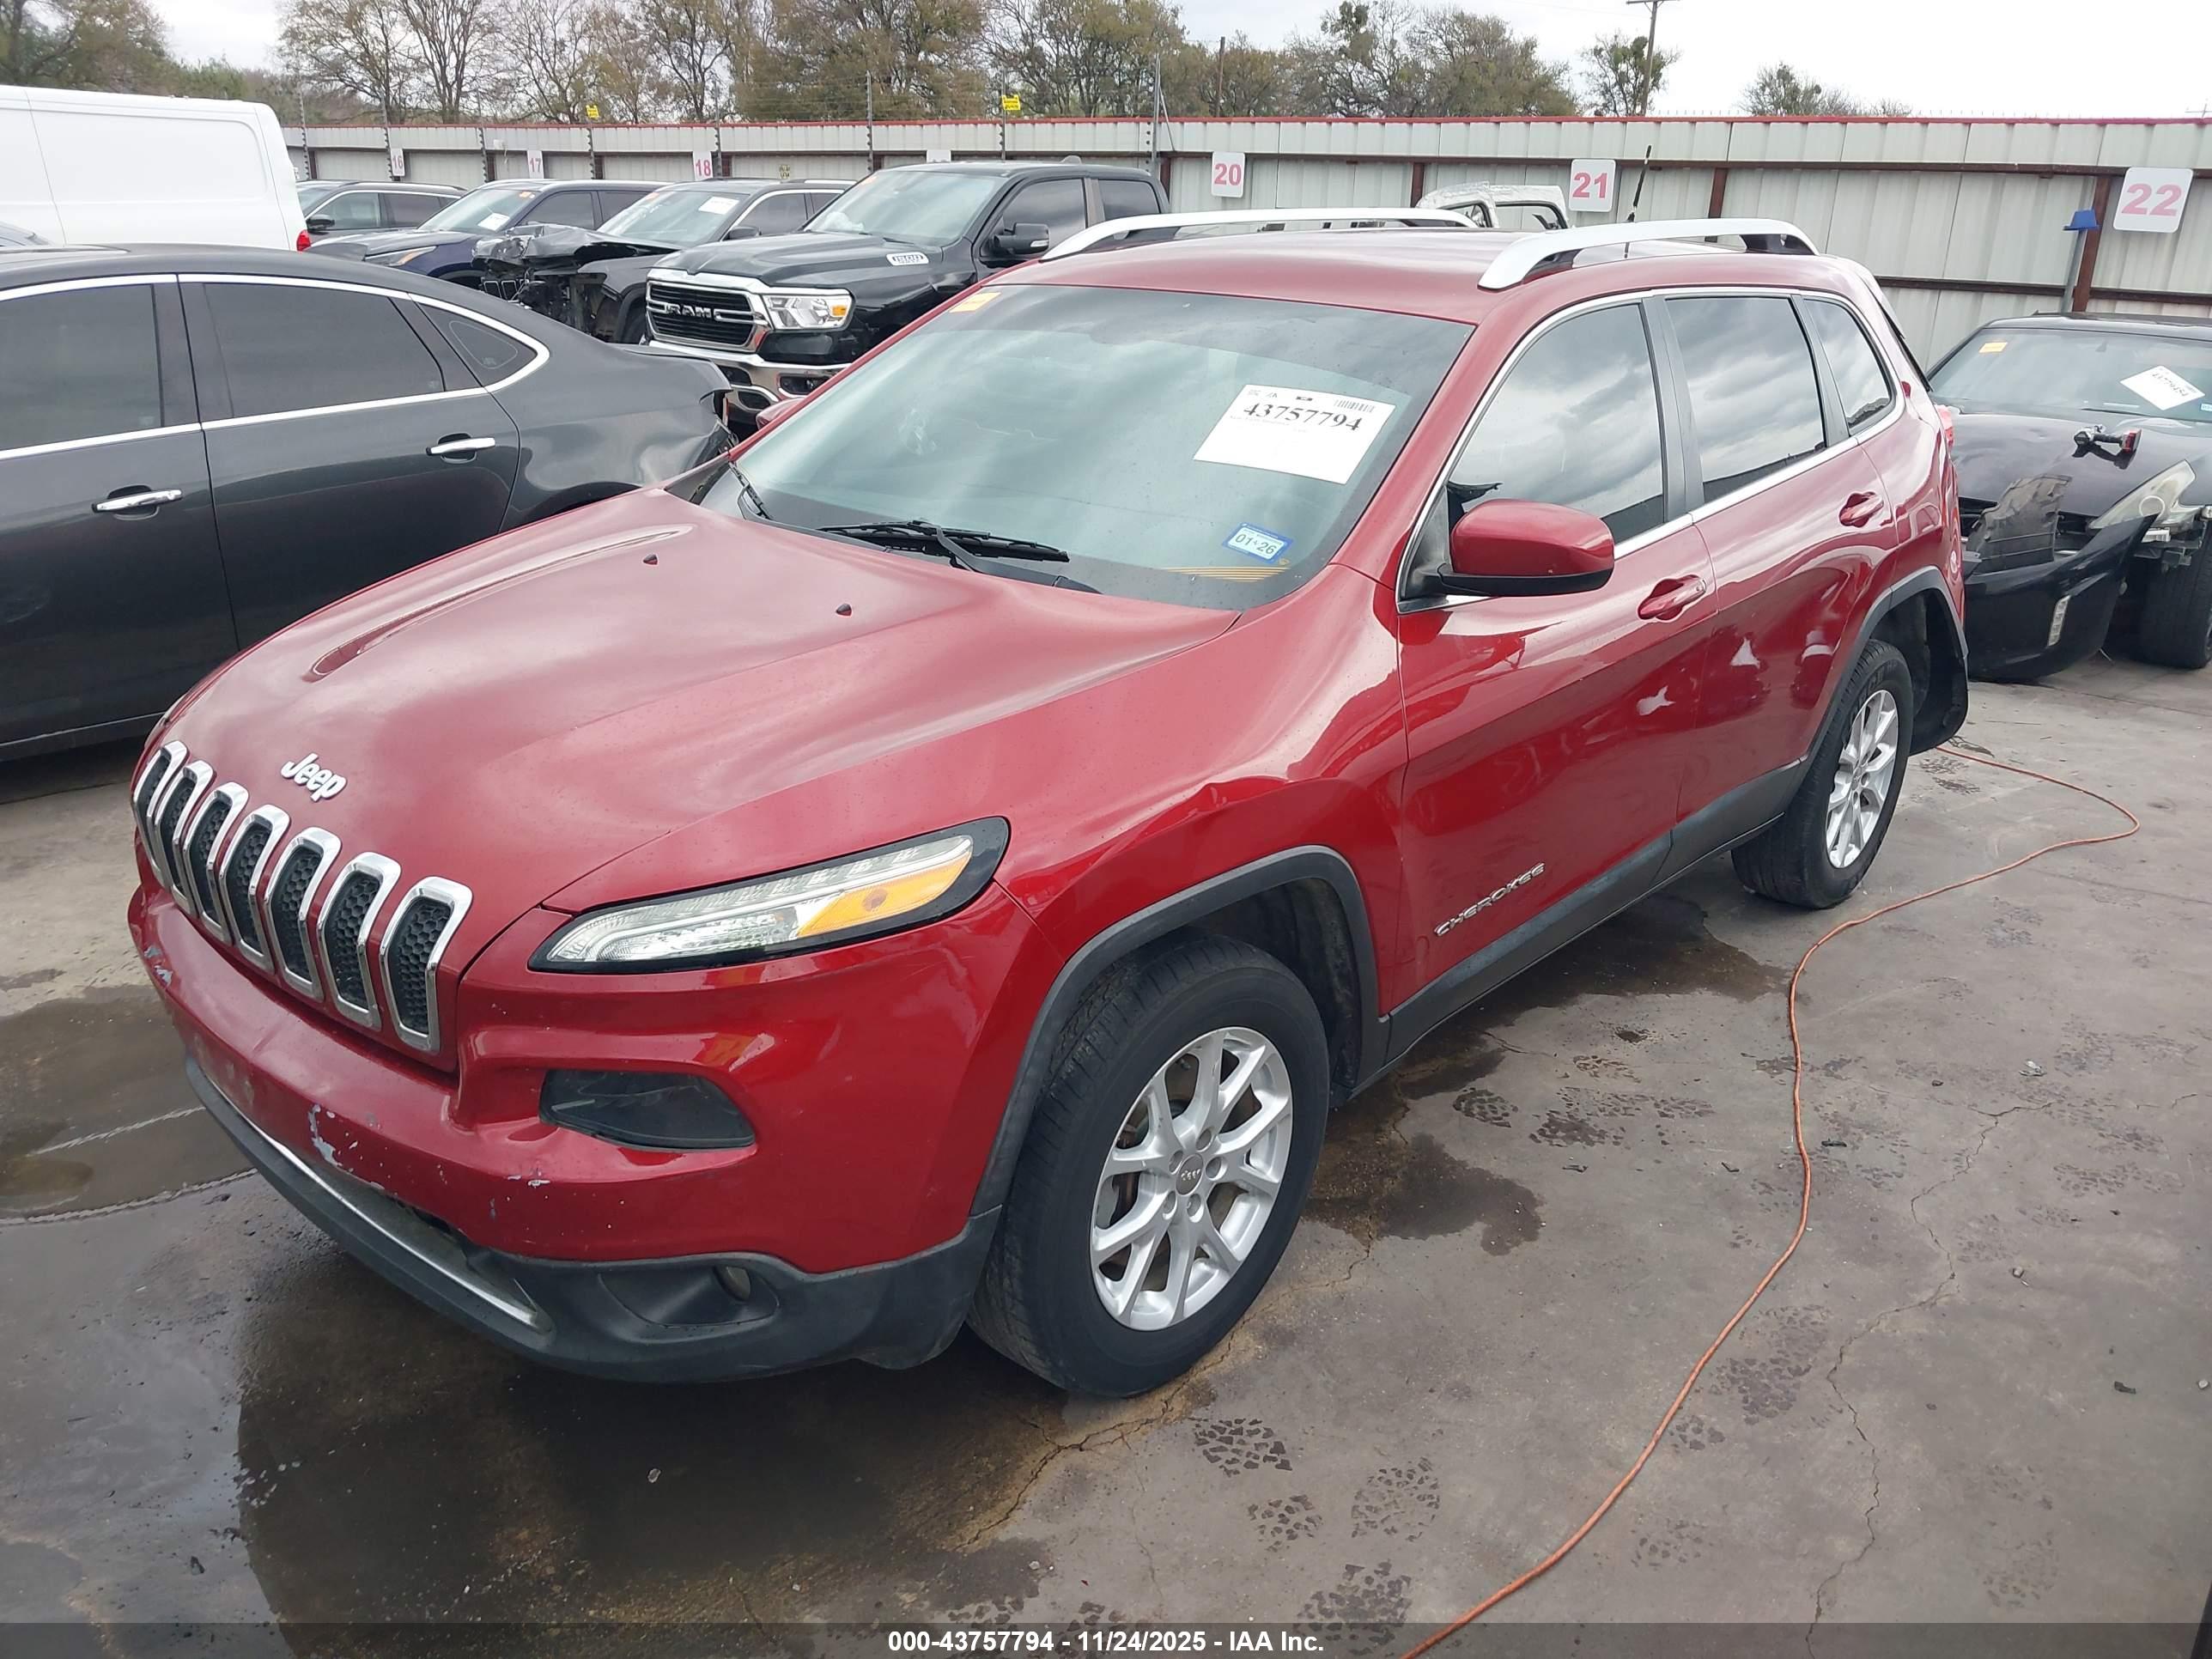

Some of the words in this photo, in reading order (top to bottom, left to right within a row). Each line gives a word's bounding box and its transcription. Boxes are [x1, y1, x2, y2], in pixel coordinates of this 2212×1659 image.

[392, 155, 404, 169] 16
[530, 157, 541, 173] 17
[696, 160, 712, 177] 18
[1214, 163, 1242, 185] 20
[1572, 172, 1607, 198] 21
[2121, 183, 2183, 216] 22
[668, 303, 712, 318] RAM
[1243, 402, 1363, 431] 43757794
[280, 752, 348, 803] Jeep
[1434, 862, 1547, 937] CHEROKEE
